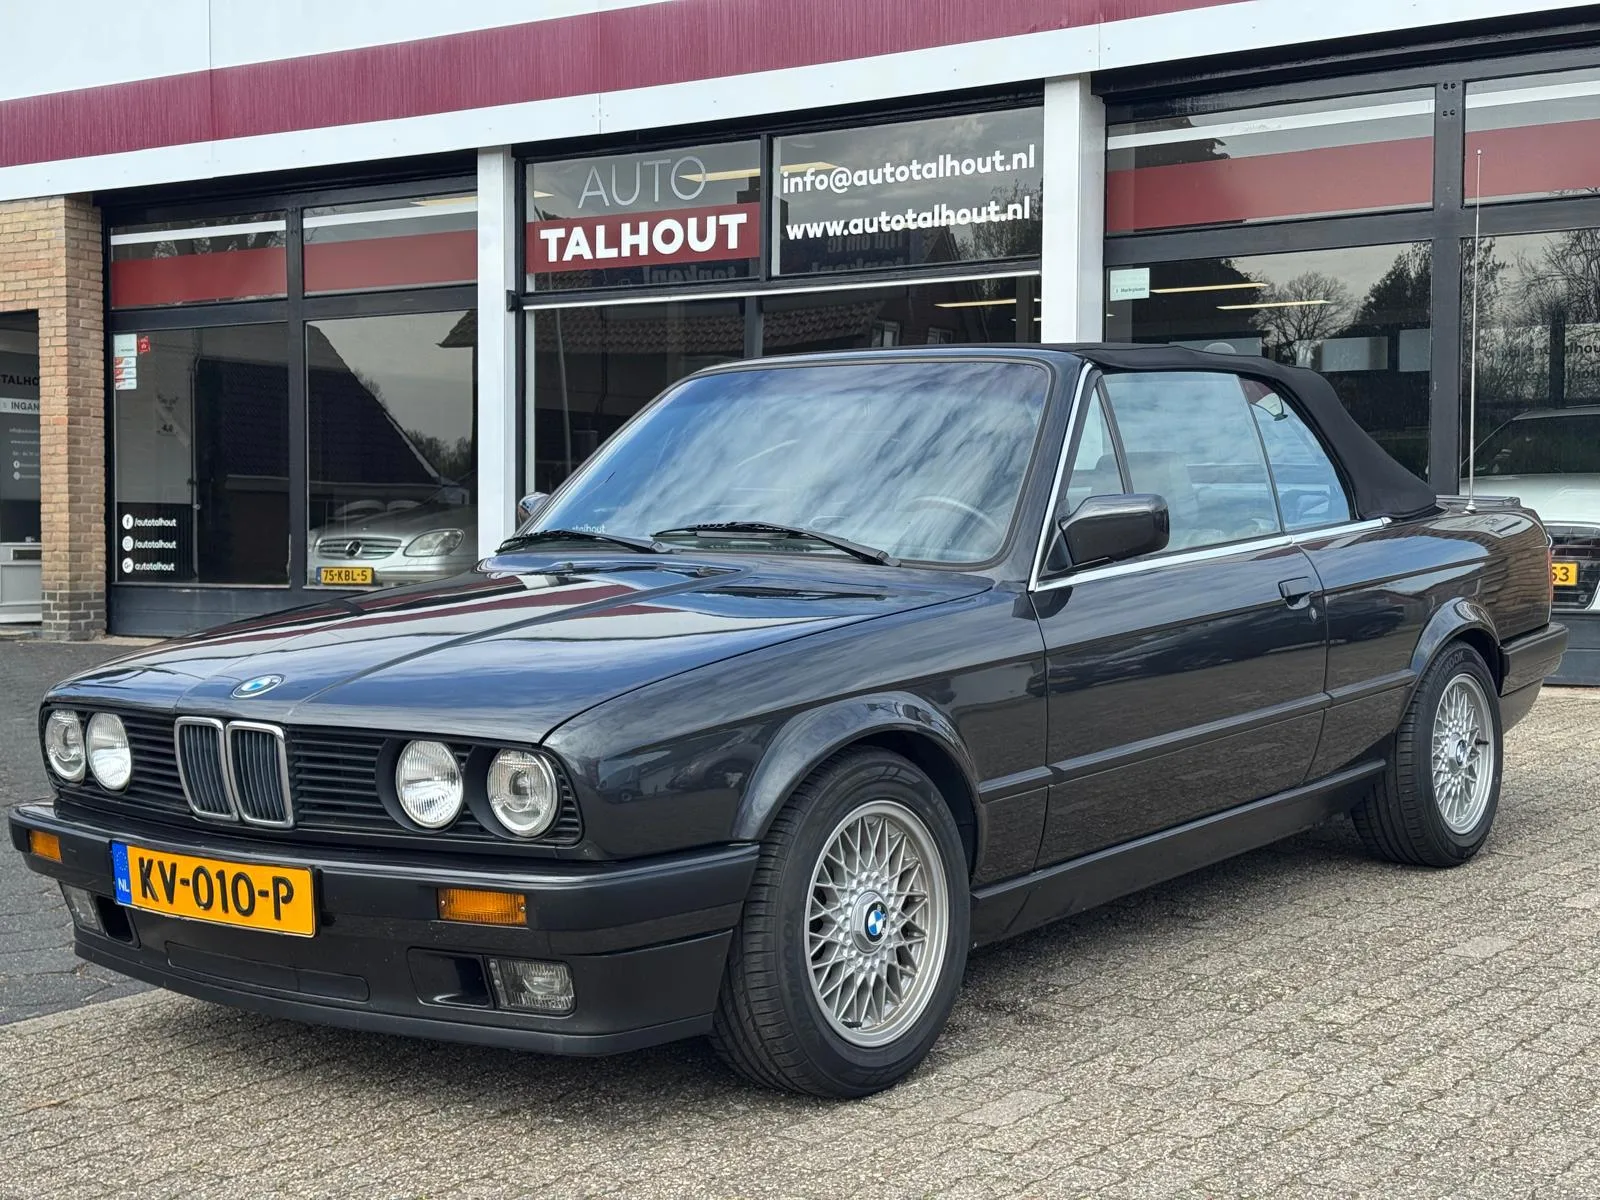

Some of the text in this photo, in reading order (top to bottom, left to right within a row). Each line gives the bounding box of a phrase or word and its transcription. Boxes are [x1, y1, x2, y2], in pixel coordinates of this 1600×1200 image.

[577, 155, 707, 209] AUTO
[783, 143, 1036, 193] info@autotalhout.nl
[538, 213, 748, 263] TALHOUT
[786, 195, 1031, 241] www.autotalhout.nl
[134, 517, 177, 527] /autotalhout
[134, 539, 177, 549] /autotalhout
[323, 569, 368, 582] 75-KBL-5
[118, 877, 130, 892] NL
[138, 856, 295, 921] KV-010-P
